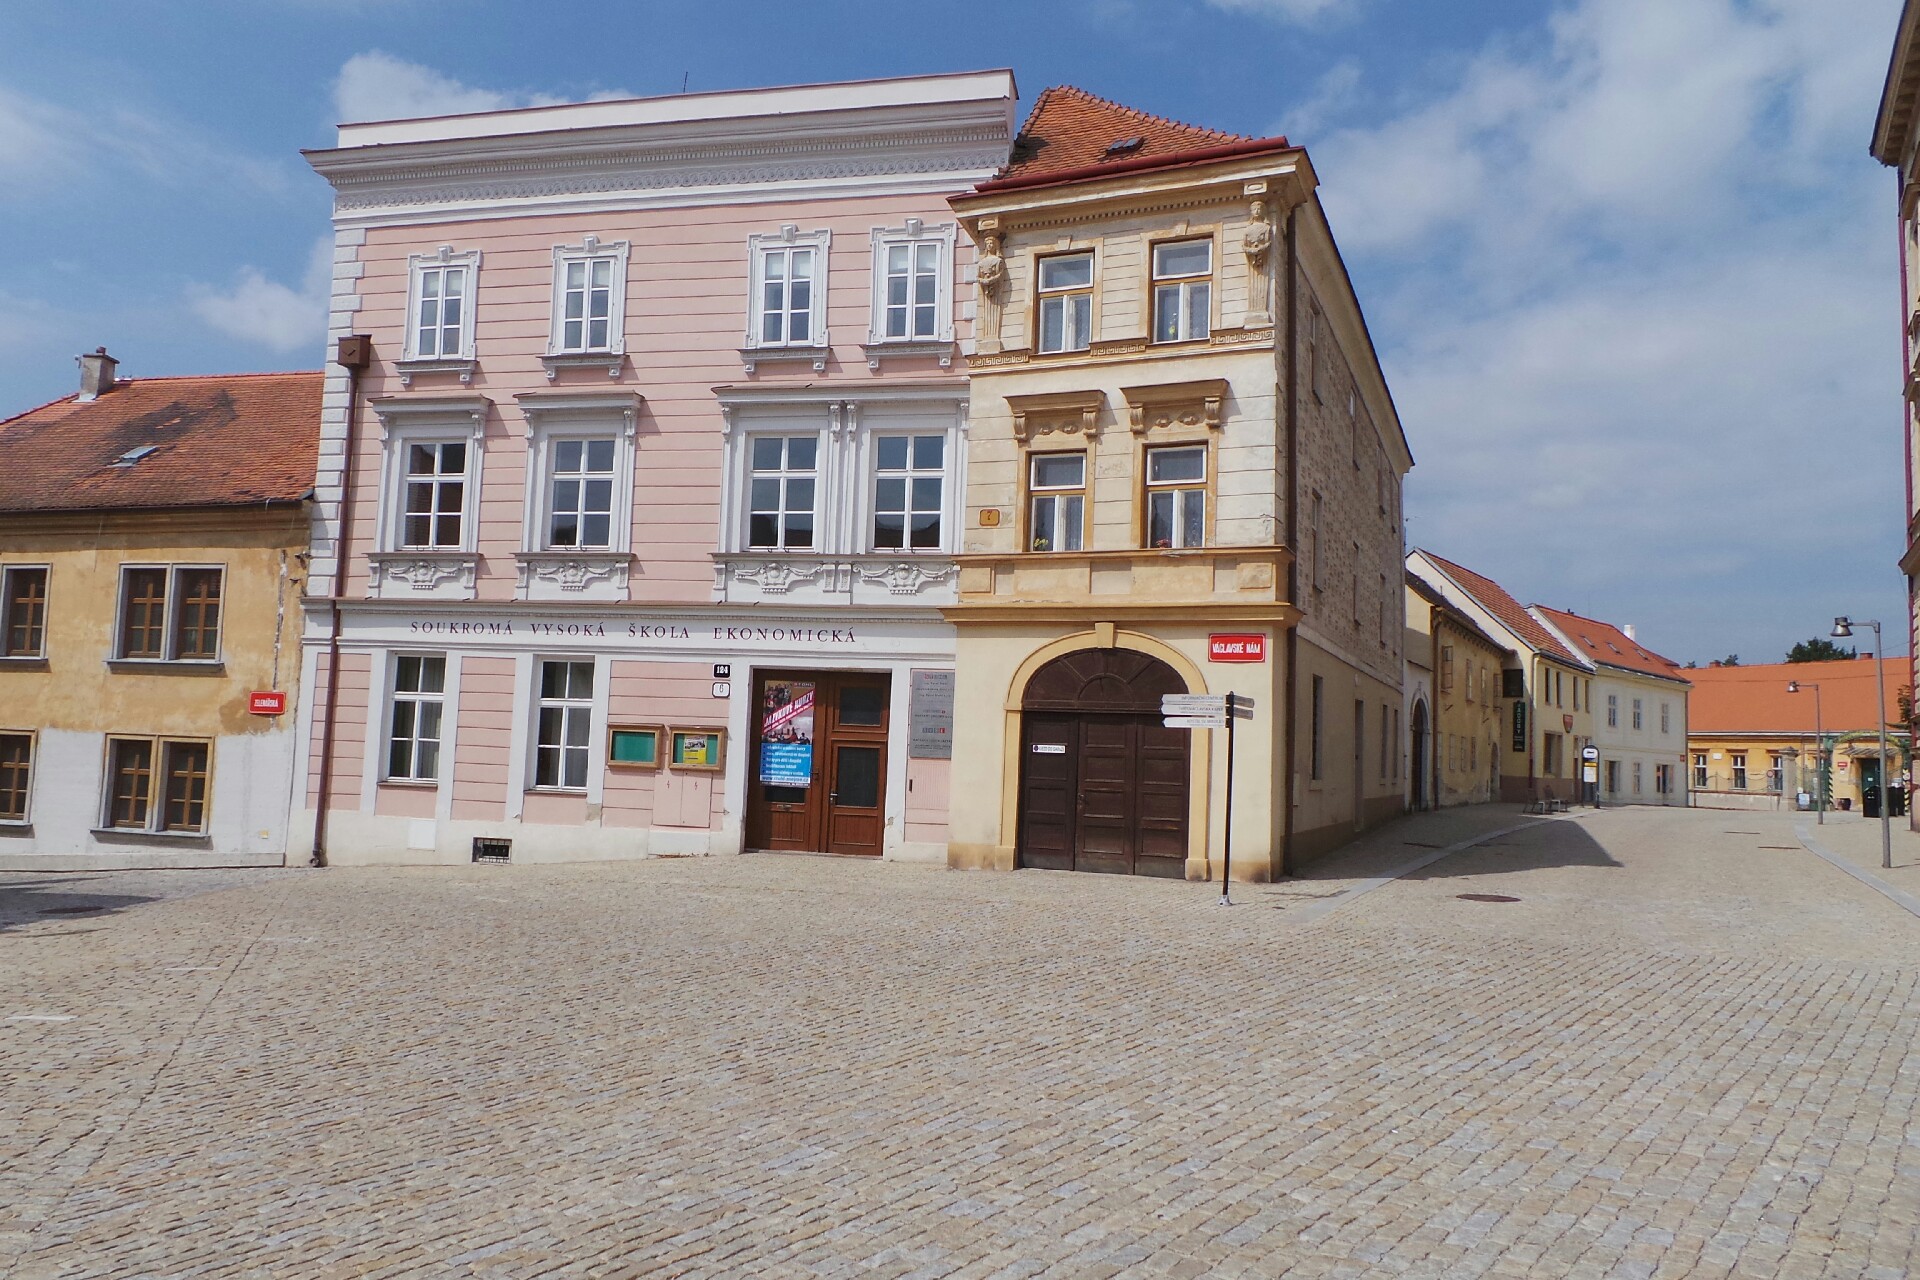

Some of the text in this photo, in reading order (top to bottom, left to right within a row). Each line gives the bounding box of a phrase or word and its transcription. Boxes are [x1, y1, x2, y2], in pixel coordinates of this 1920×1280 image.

[987, 510, 993, 521] 7
[410, 619, 856, 643] SOUKROMÁ VYSOKÁ ŠKOLA EKONOMICKÁ
[1212, 641, 1244, 654] VÁCLAVSKÉ
[716, 665, 729, 674] 124
